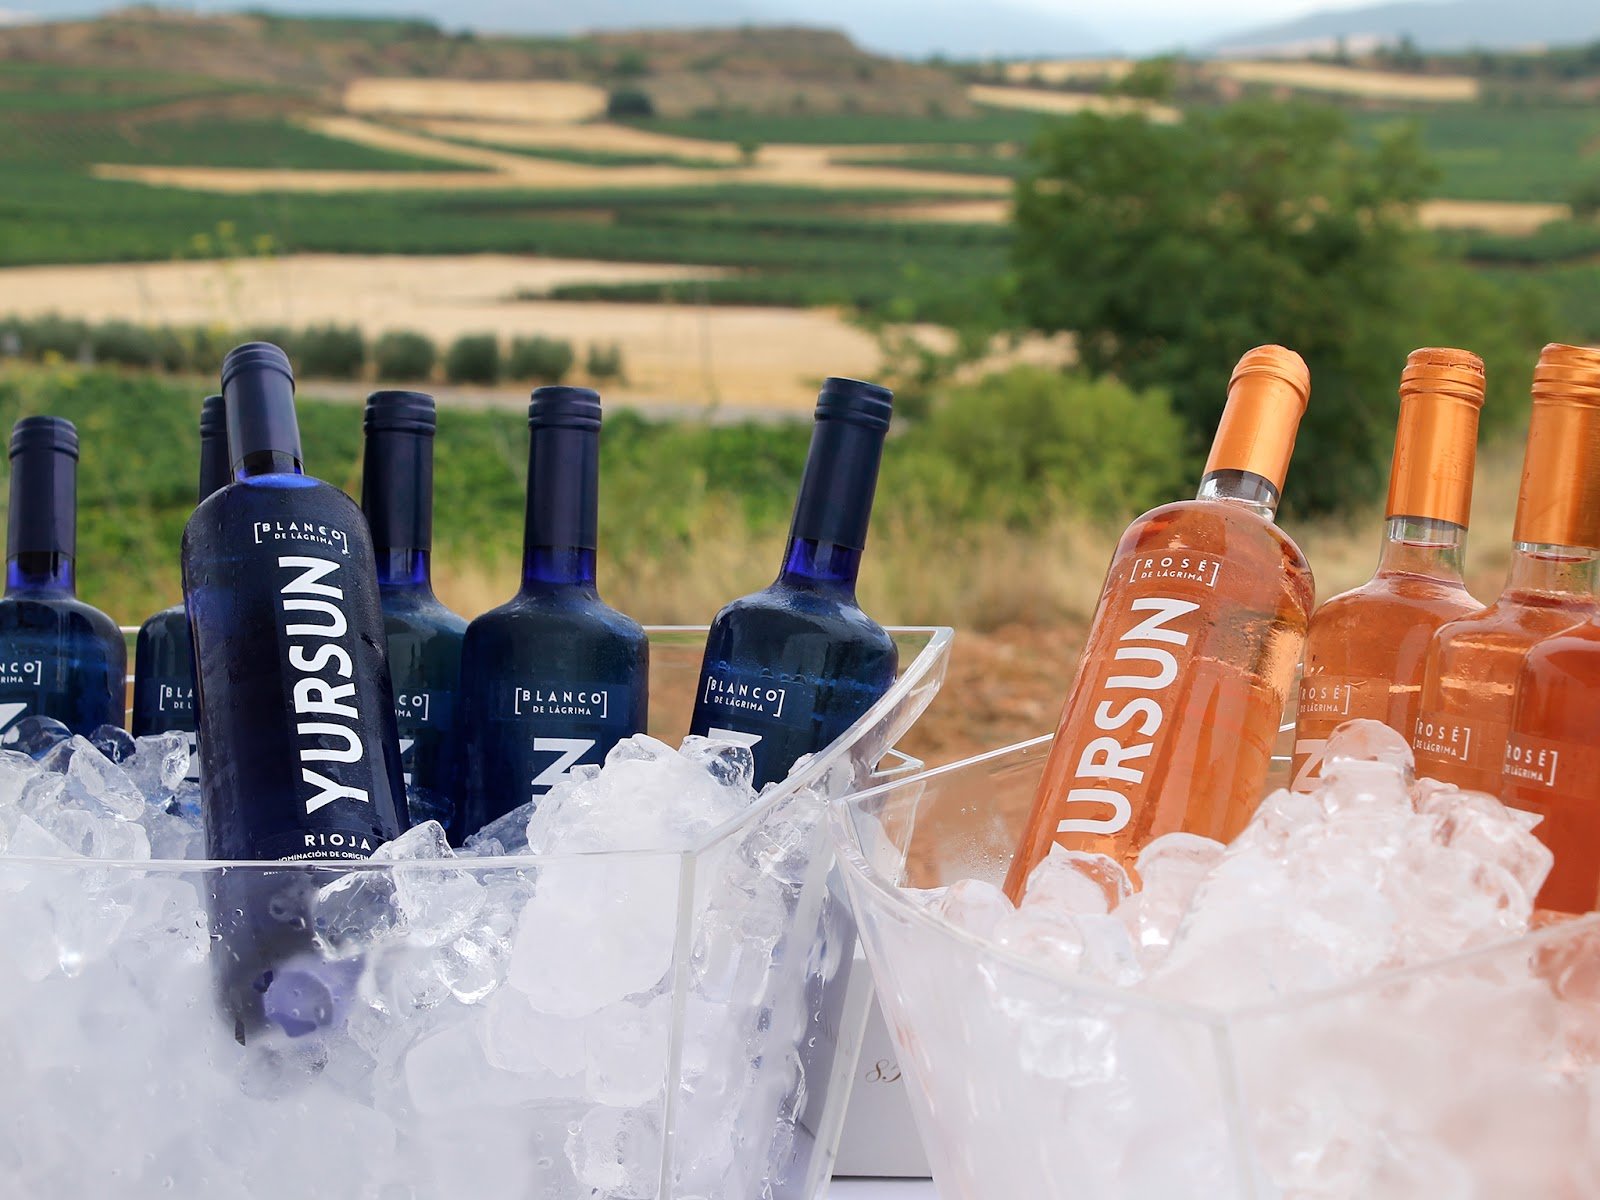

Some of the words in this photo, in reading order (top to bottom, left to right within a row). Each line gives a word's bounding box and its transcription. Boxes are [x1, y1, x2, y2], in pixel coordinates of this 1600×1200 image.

[291, 532, 334, 546] LÁGRIMA
[1140, 571, 1154, 579] DE
[1156, 569, 1203, 582] LÁGRIMA
[278, 556, 369, 815] YURSUN
[532, 705, 545, 714] DE
[549, 704, 592, 716] LÁGRIMA
[714, 695, 724, 704] DE
[725, 697, 764, 712] LÁGRIMA
[1050, 597, 1201, 853] URSUN
[304, 833, 372, 851] RIOJA
